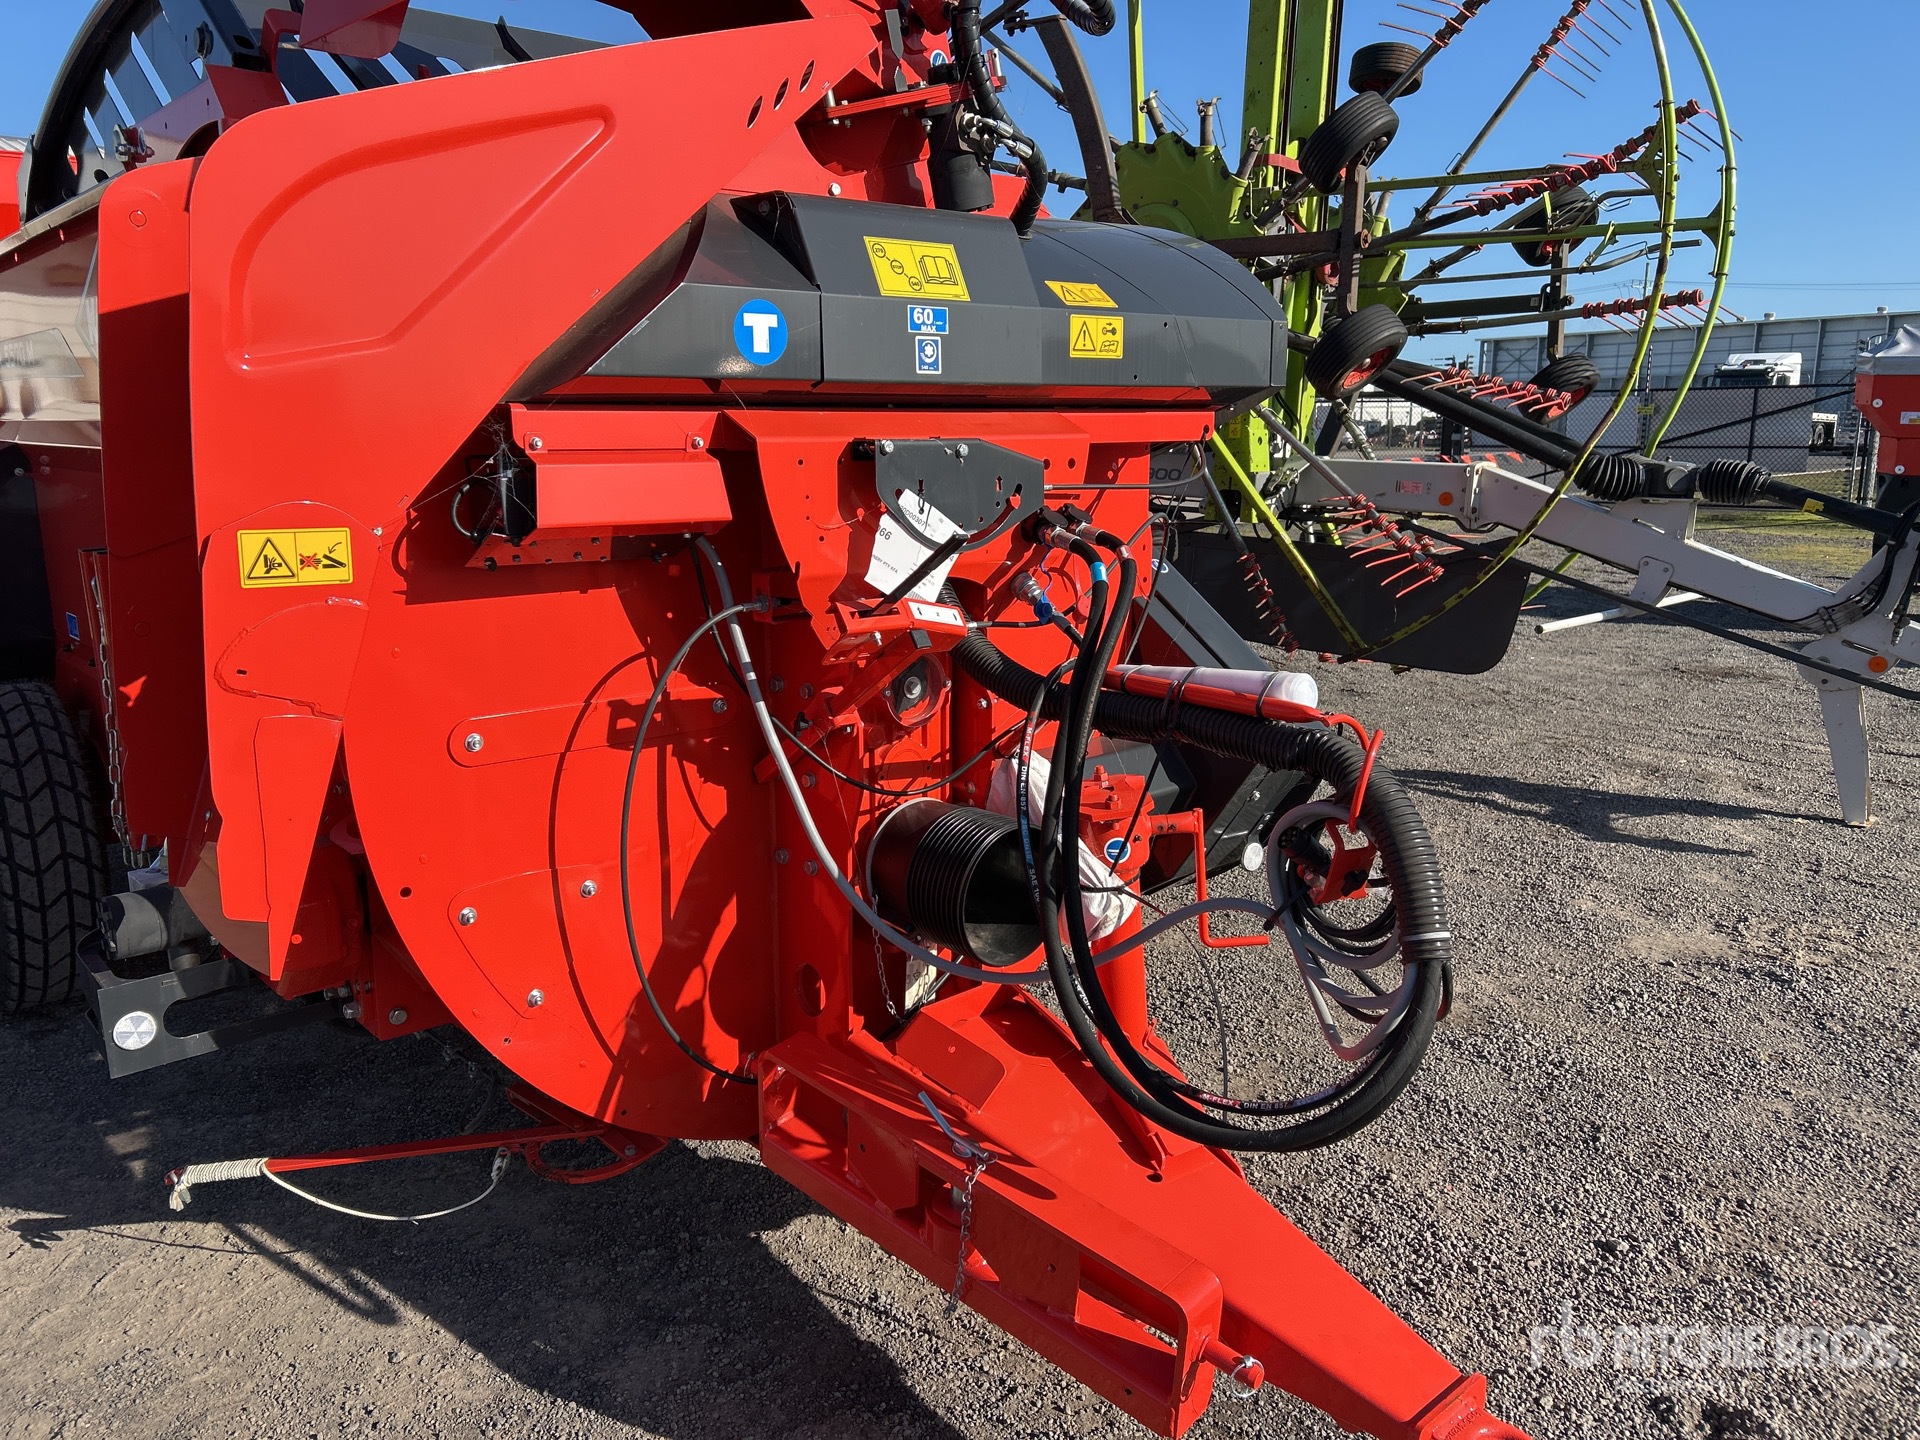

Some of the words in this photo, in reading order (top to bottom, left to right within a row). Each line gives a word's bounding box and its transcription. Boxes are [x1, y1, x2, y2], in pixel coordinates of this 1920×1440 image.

[913, 307, 934, 325] 60
[743, 312, 778, 353] T
[920, 324, 937, 333] MAX
[1029, 868, 1039, 887] SAE
[1243, 1101, 1259, 1110] DIN
[1260, 1102, 1272, 1110] EN
